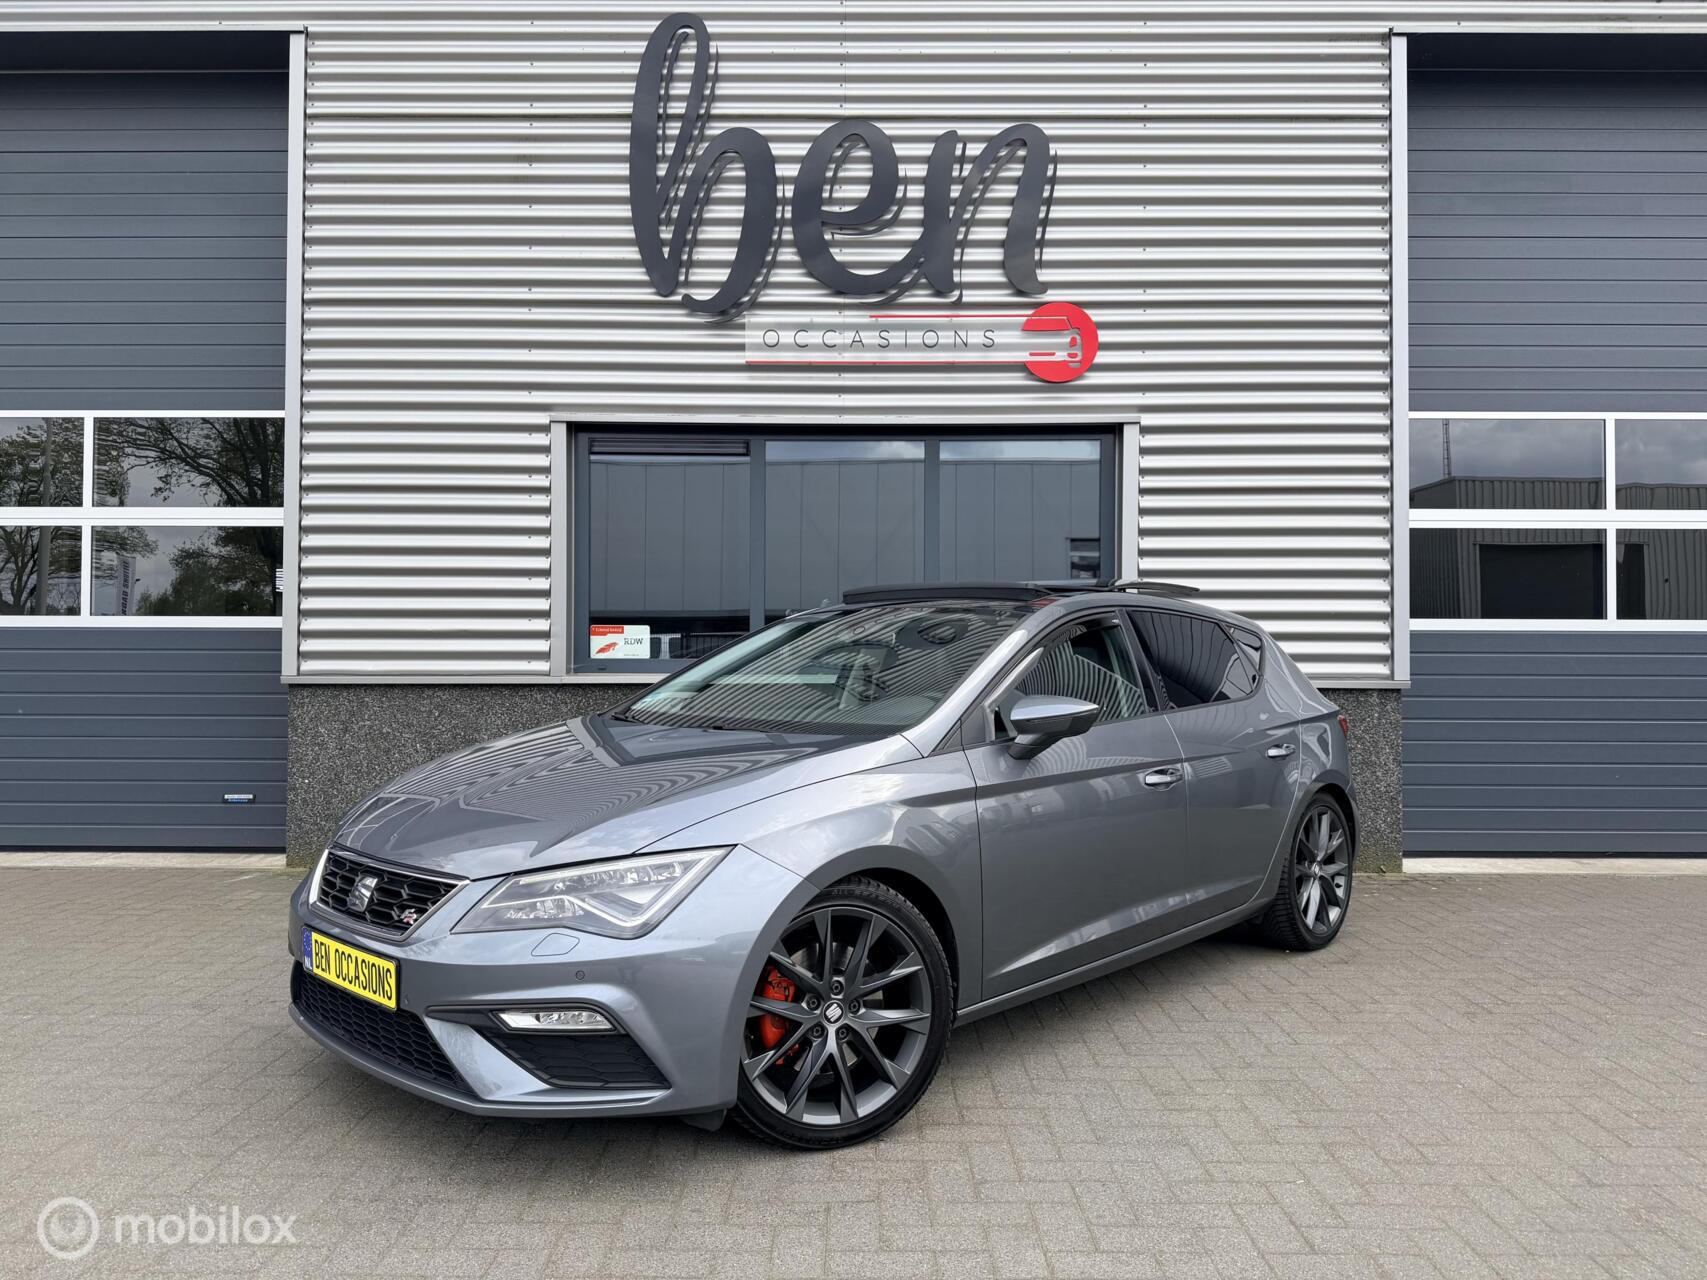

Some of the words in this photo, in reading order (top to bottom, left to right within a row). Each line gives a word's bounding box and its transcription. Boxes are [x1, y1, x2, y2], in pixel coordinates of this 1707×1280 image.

[629, 12, 1052, 316] ben
[762, 329, 996, 349] OCCASIONS
[623, 637, 644, 646] RDW
[314, 939, 331, 975] BEN
[334, 948, 393, 1001] OCCASIONS
